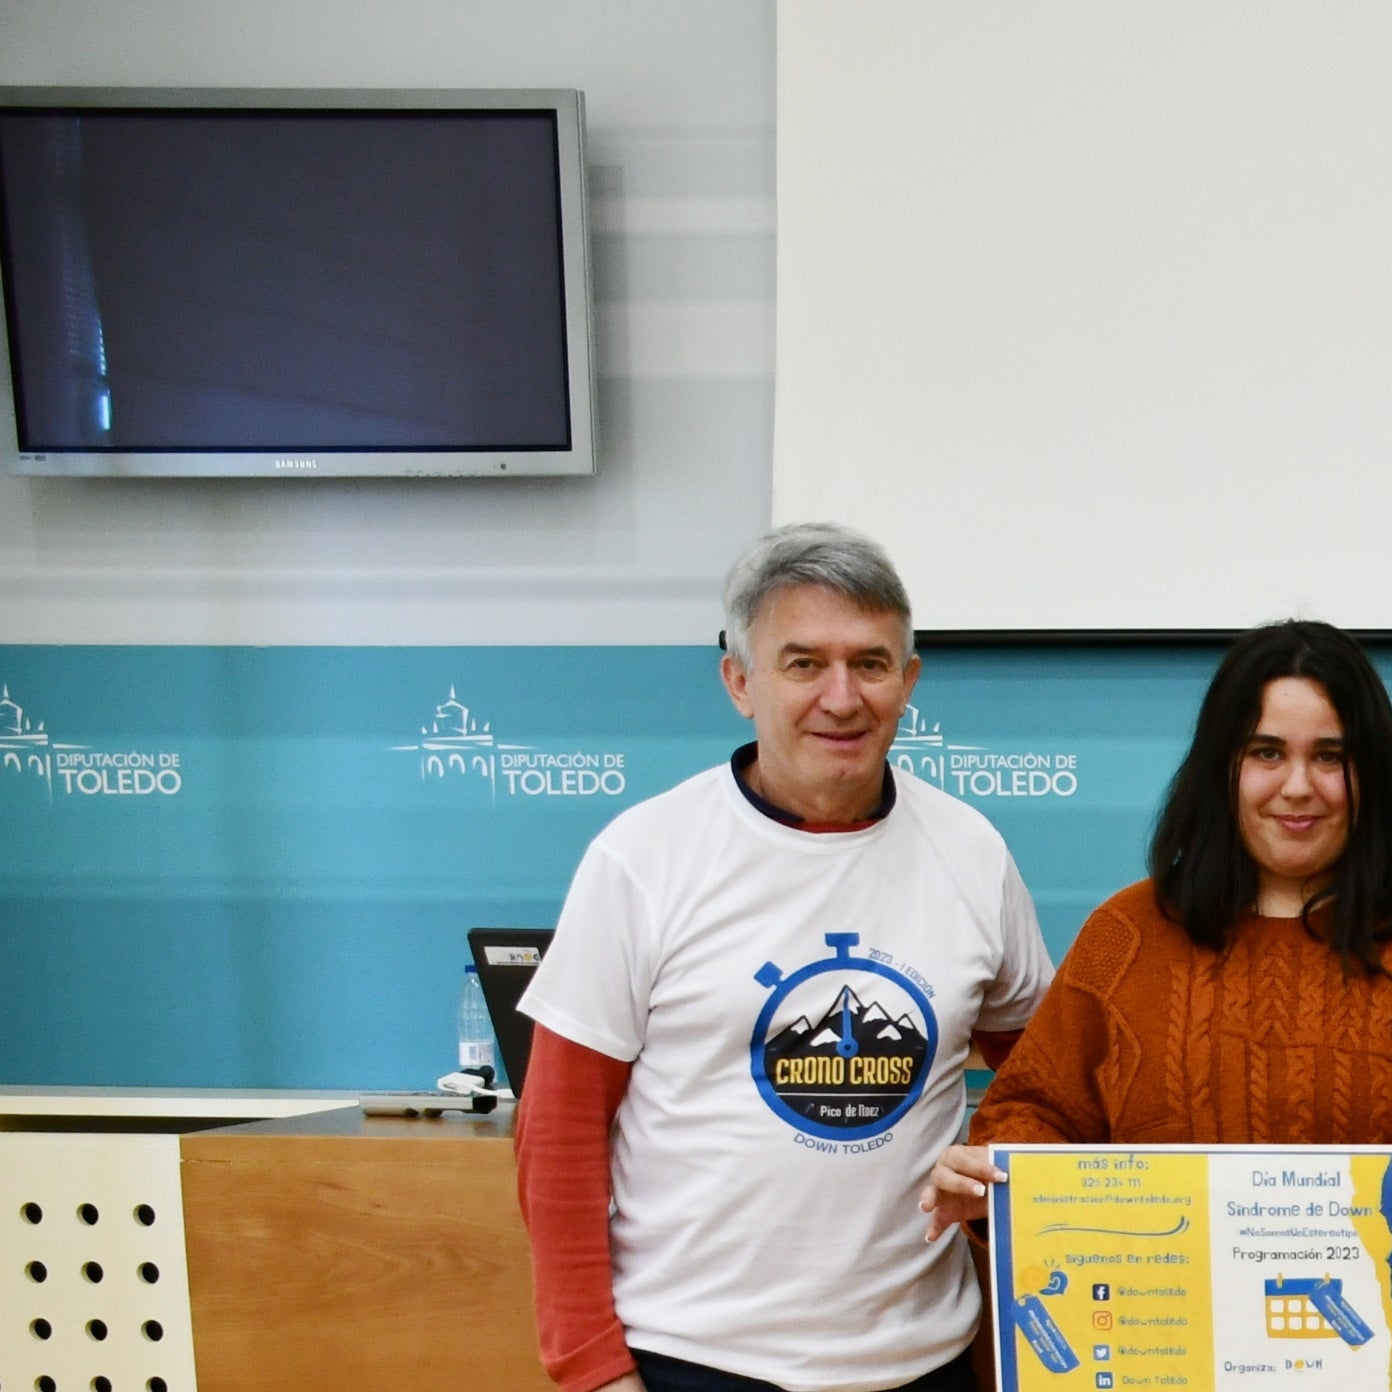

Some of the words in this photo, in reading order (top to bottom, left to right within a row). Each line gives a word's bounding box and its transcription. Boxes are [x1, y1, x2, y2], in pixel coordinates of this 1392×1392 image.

[275, 460, 318, 469] SAMSUNG
[56, 751, 155, 767] DIPUTACIÓN
[158, 753, 180, 767] DE
[501, 752, 599, 768] DIPUTACIÓN
[604, 754, 625, 768] DE
[950, 752, 1051, 769] DIPUTACIÓN
[1055, 755, 1077, 769] DE
[58, 769, 182, 794] TOLEDO
[502, 769, 626, 795] TOLEDO
[951, 770, 1078, 796] TOLEDO
[869, 947, 894, 965] 2023
[776, 1057, 844, 1084] CRONO
[849, 1056, 913, 1085] CROSS
[820, 1105, 842, 1117] Pico
[846, 1103, 857, 1117] de
[793, 1133, 838, 1154] DOWN
[843, 1132, 893, 1154] TOLEDO
[1078, 1155, 1108, 1170] más
[1114, 1154, 1149, 1170] info:
[1252, 1171, 1276, 1187] Día
[1282, 1171, 1341, 1187] Mundial
[1306, 1202, 1323, 1216] de
[1329, 1201, 1372, 1217] Down
[1127, 1254, 1142, 1263] en
[1147, 1253, 1190, 1264] redes:
[1233, 1247, 1322, 1262] Programación
[1326, 1246, 1360, 1260] 2023
[1224, 1361, 1276, 1374] Organiza:
